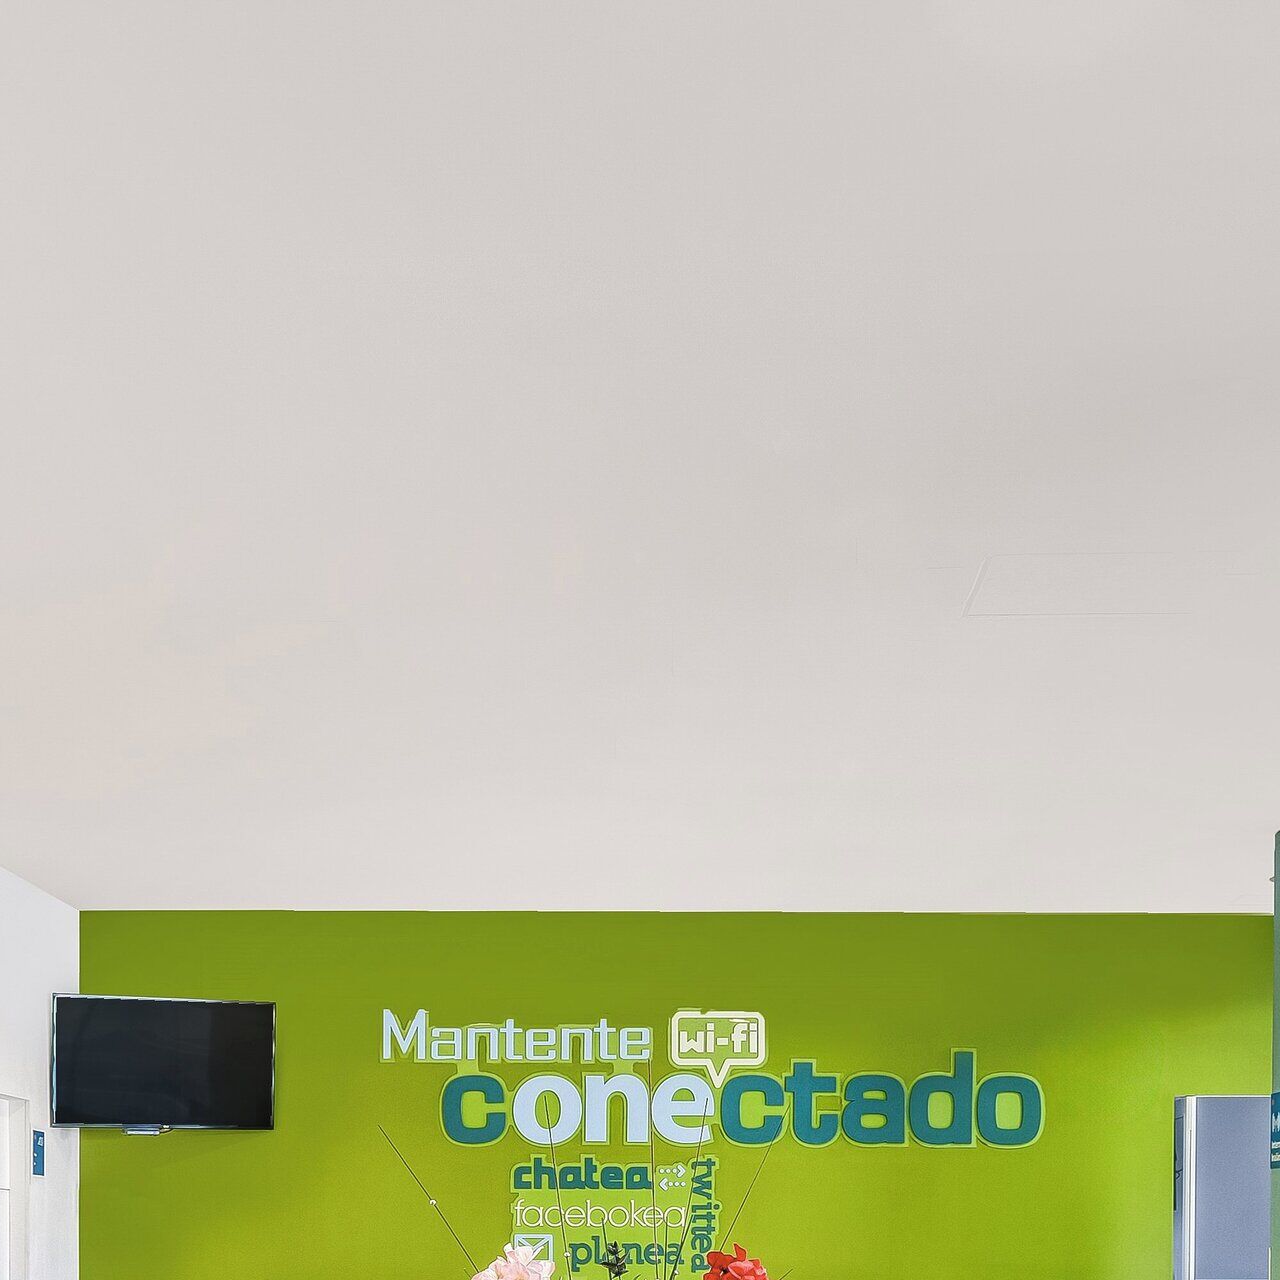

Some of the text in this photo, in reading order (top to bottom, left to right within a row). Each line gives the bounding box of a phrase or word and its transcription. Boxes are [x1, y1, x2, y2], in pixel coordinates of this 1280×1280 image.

[382, 1008, 650, 1060] Mantente
[679, 1022, 758, 1054] wi-fi
[441, 1050, 1043, 1145] conectado
[513, 1157, 653, 1190] chatea
[514, 1199, 687, 1228] facebokea
